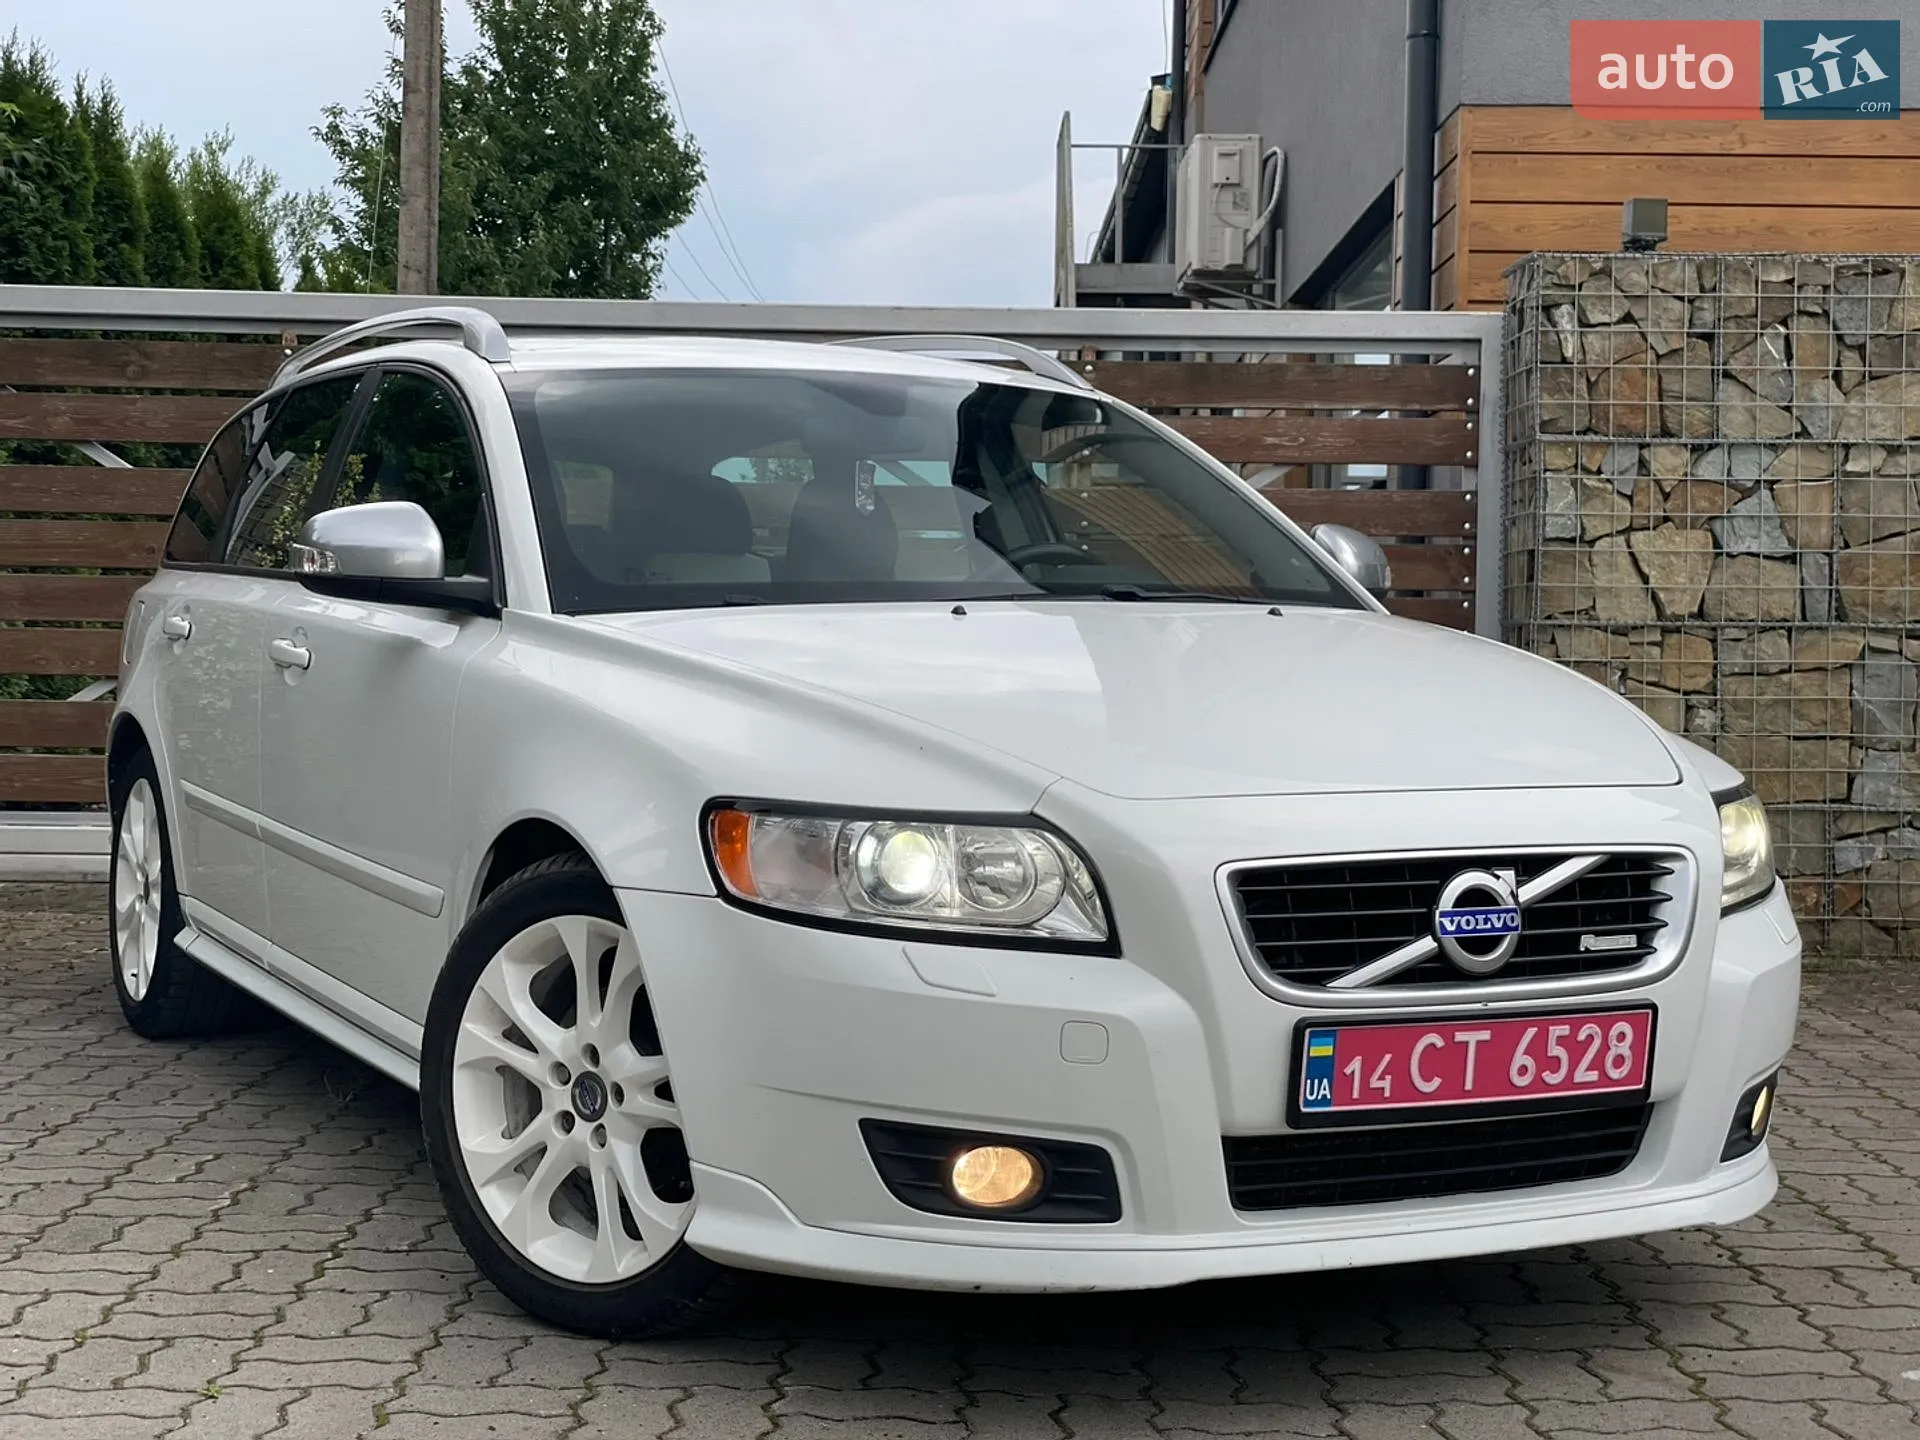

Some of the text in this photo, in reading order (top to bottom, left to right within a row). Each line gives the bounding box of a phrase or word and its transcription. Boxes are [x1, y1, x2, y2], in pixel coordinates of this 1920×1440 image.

[1439, 912, 1520, 931] VOLVO
[1343, 1020, 1634, 1099] 14 CT 6528
[1305, 1078, 1331, 1101] UA
